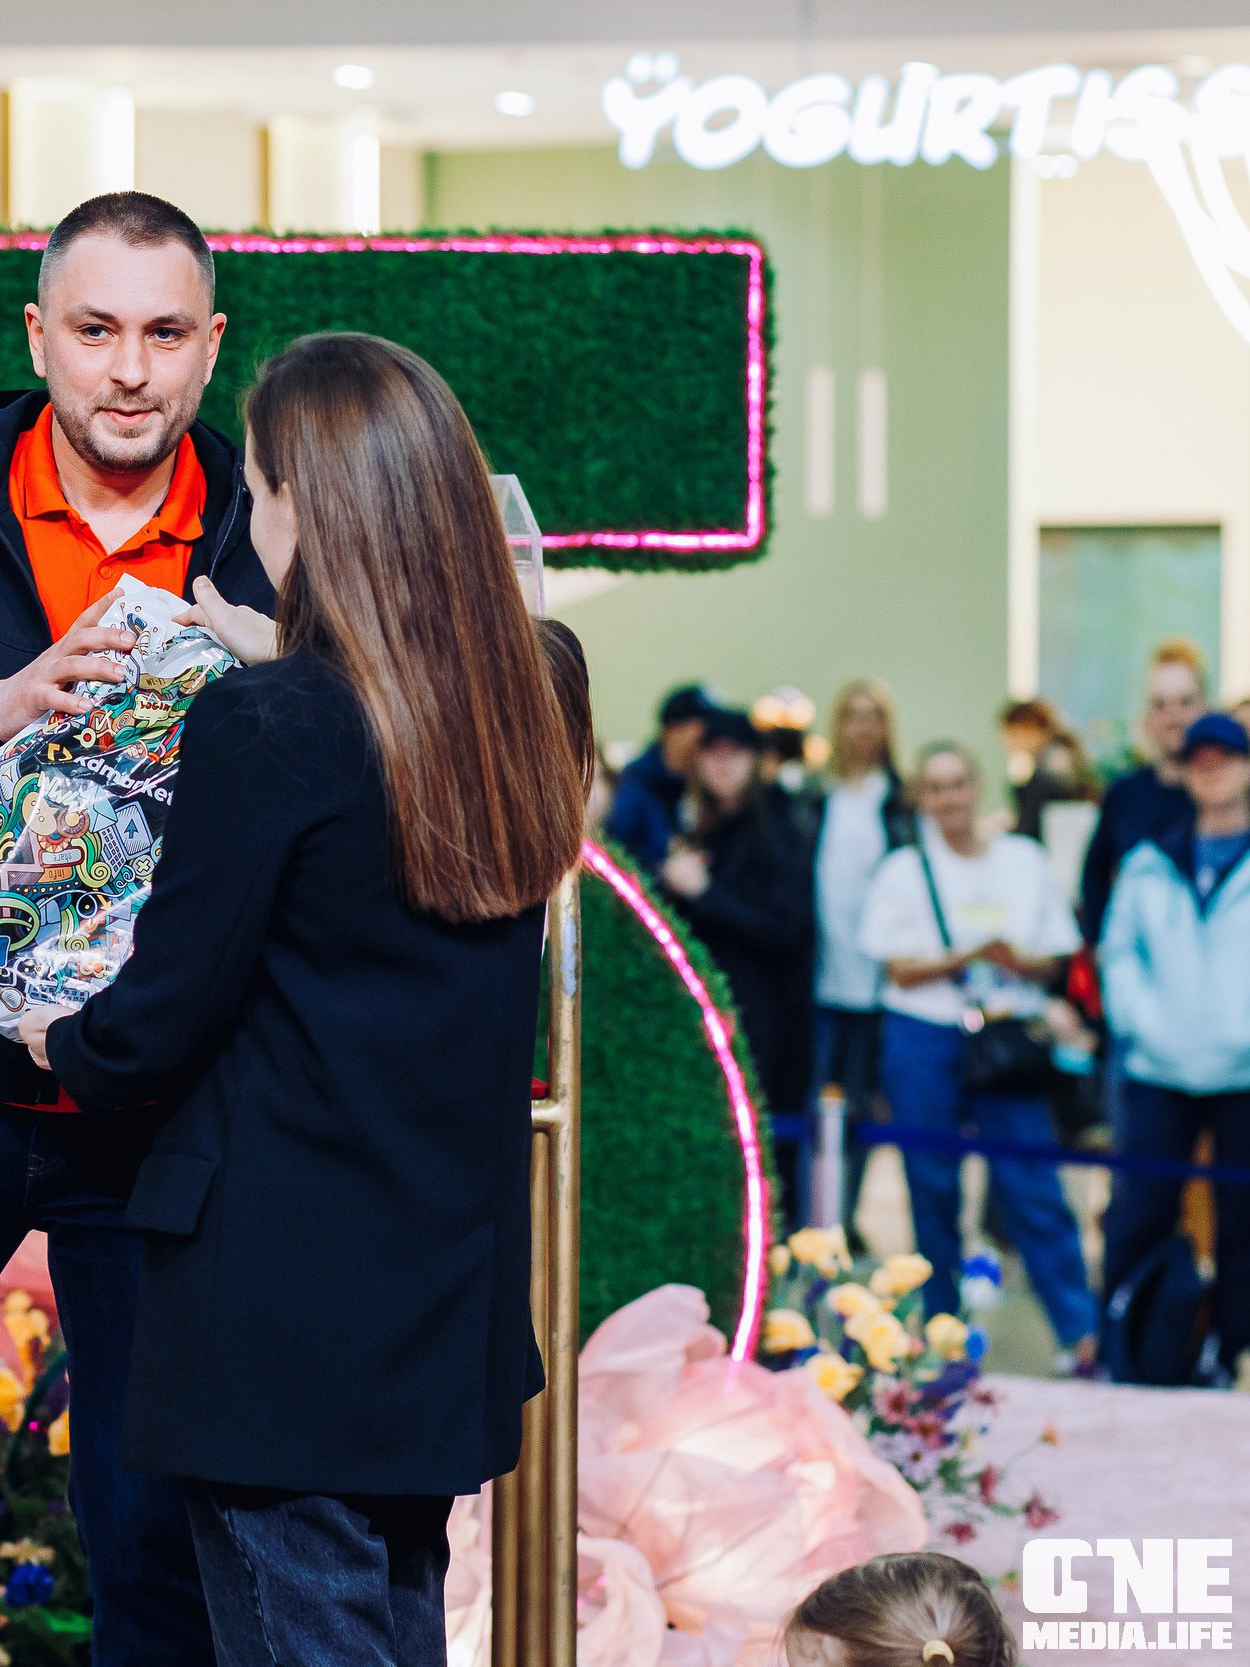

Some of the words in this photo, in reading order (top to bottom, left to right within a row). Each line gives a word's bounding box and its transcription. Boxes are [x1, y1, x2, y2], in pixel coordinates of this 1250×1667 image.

[140, 701, 170, 711] LOGIN
[53, 853, 72, 862] share
[48, 869, 65, 880] info
